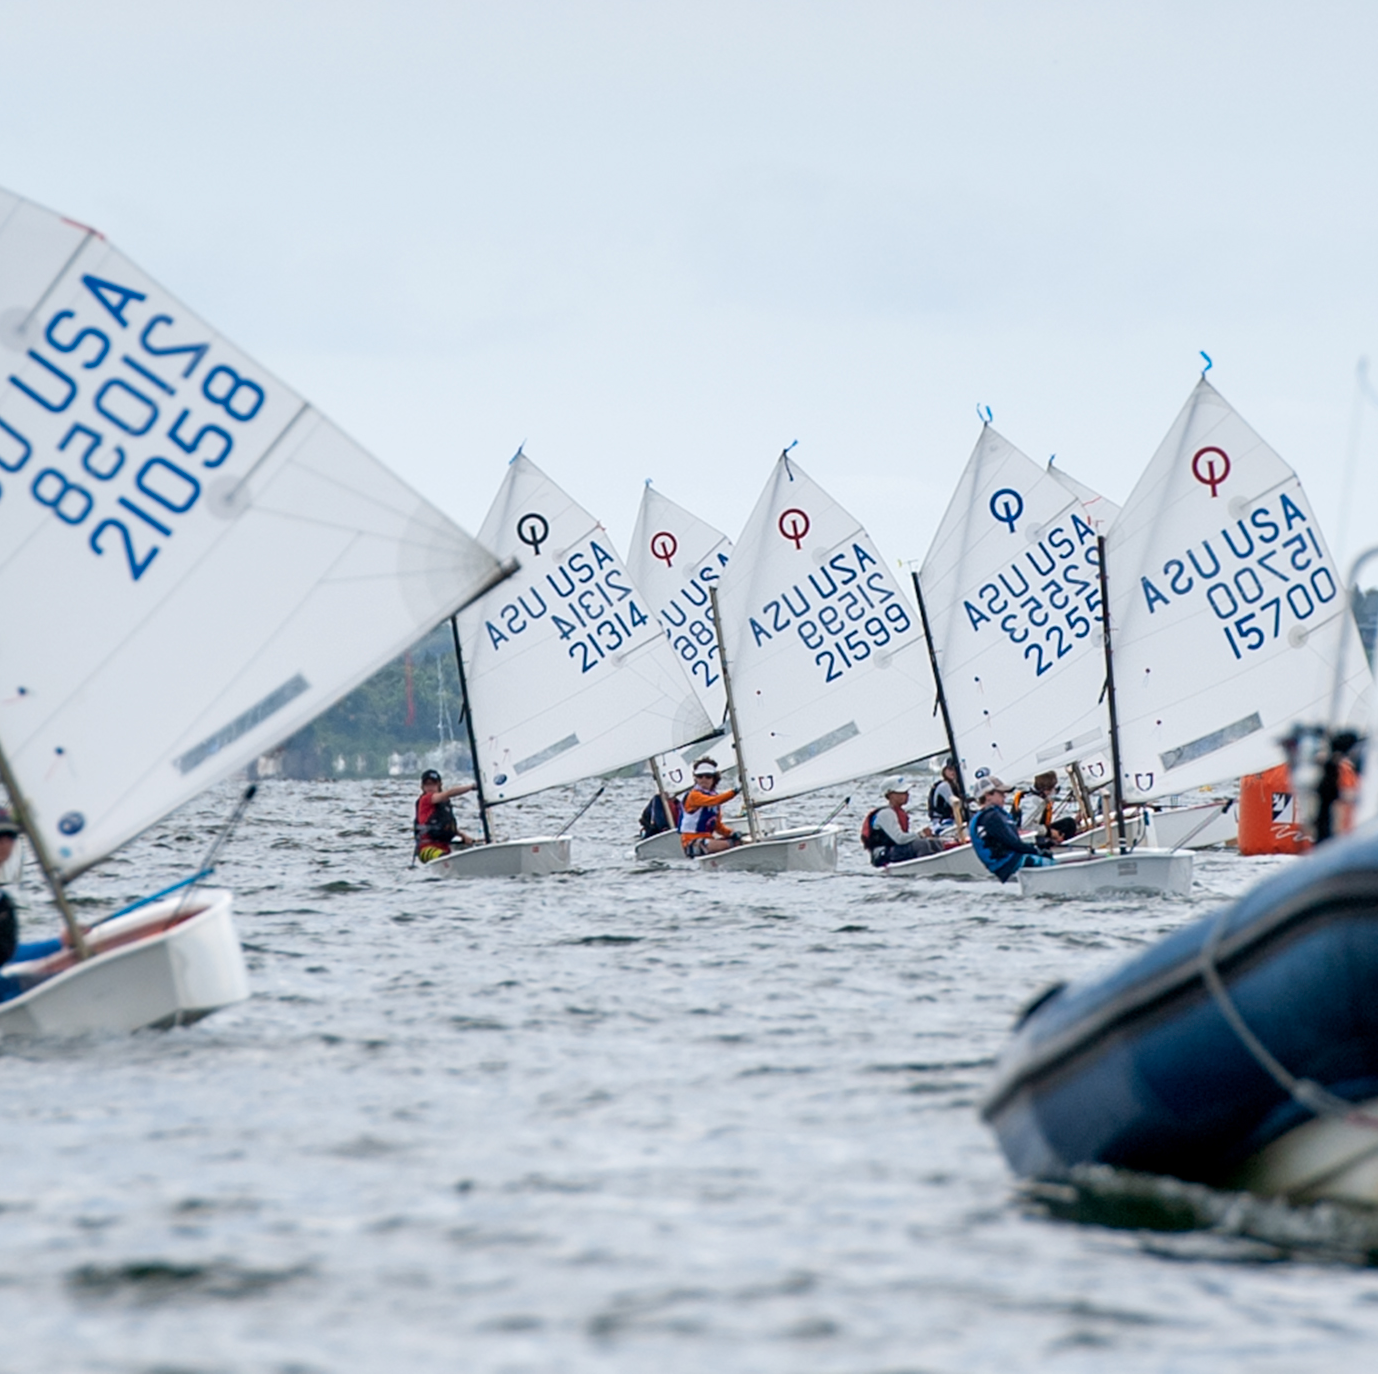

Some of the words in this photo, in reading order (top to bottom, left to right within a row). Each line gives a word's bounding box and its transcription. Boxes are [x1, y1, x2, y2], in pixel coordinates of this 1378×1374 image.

[8, 273, 146, 413] USA
[89, 364, 265, 581] 21058
[1025, 514, 1096, 576] USA
[1221, 493, 1307, 559] USA
[546, 540, 614, 597] USA
[808, 543, 877, 599] USA
[569, 600, 648, 673] 21314
[815, 603, 911, 683] 21599
[1024, 588, 1103, 677] 2255
[1223, 567, 1336, 660] 15700
